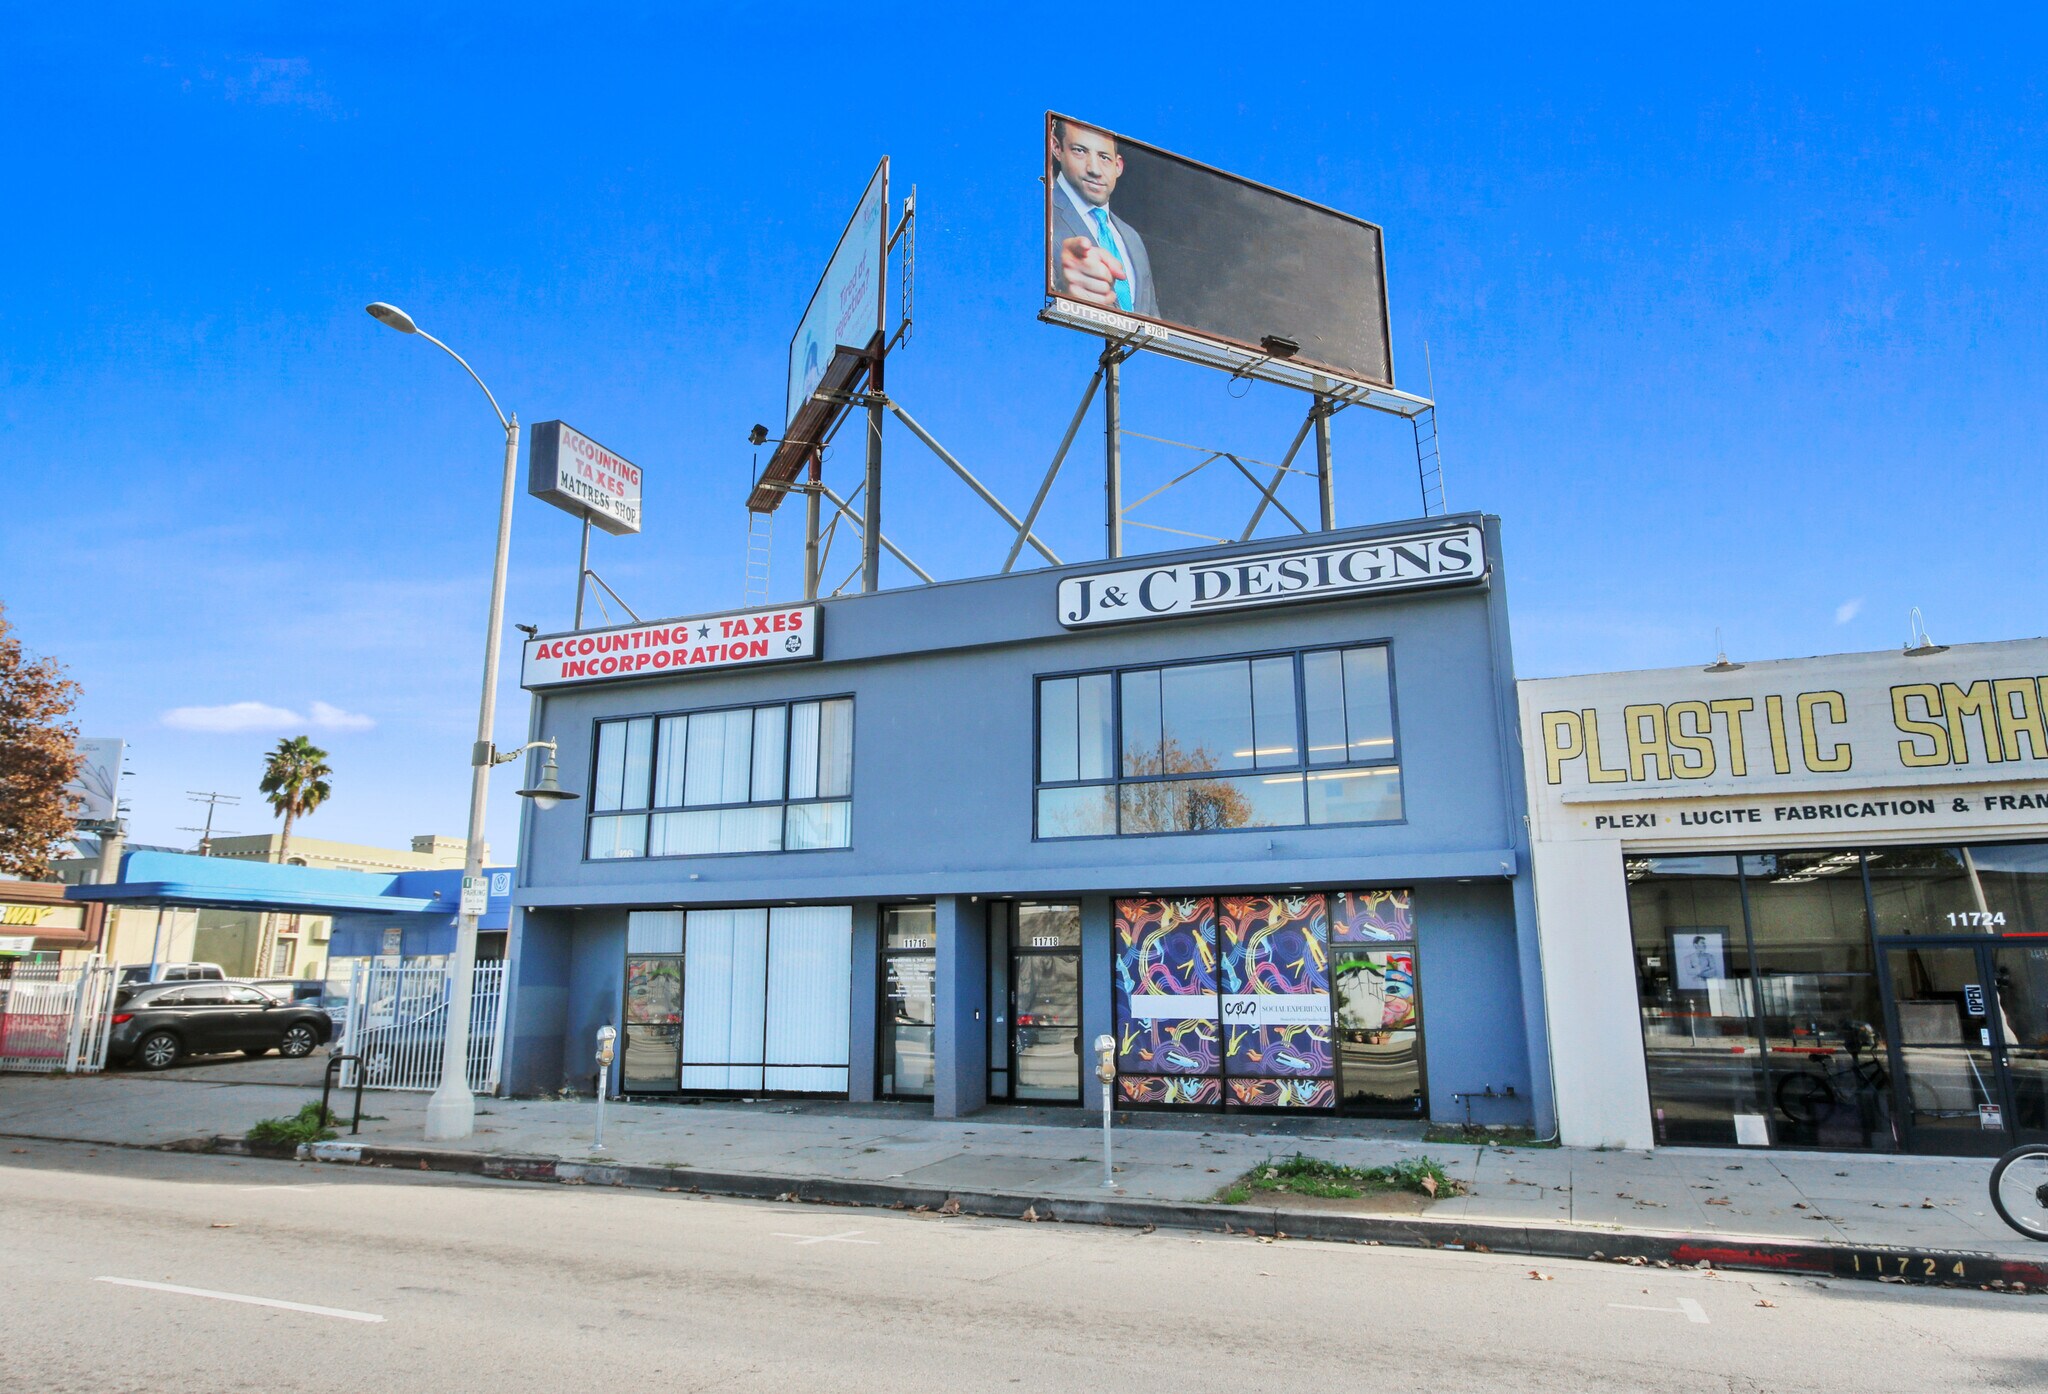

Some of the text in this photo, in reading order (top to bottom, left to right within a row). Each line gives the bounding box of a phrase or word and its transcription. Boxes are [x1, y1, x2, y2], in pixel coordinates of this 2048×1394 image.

[1060, 300, 1166, 337] OUTFRONT 3781
[562, 430, 639, 486] ACCOUNTING
[575, 458, 625, 497] TAXES
[560, 470, 637, 523] MATTRESS SHOP
[1068, 537, 1472, 621] J & C DESIGNS
[535, 612, 803, 660] ACCOUNTING TAXES
[561, 640, 768, 678] INCORPORATION
[1541, 690, 1852, 785] PLASTIC
[1595, 813, 1657, 830] PLEXI
[1680, 808, 1762, 827] LUCITE
[1774, 799, 1936, 822] FABRICATION
[1952, 798, 1970, 812] &
[463, 889, 486, 897] PARKING
[1947, 911, 2007, 927] 11724
[904, 939, 927, 948] 11716
[1034, 937, 1058, 947] 11718
[1261, 1005, 1287, 1013] SOCIAL
[1288, 1004, 1329, 1013] EXPERIENCE
[1966, 986, 1984, 1013] OPEN
[1853, 1254, 1965, 1277] 11724
[1915, 1247, 1992, 1258] SMART
